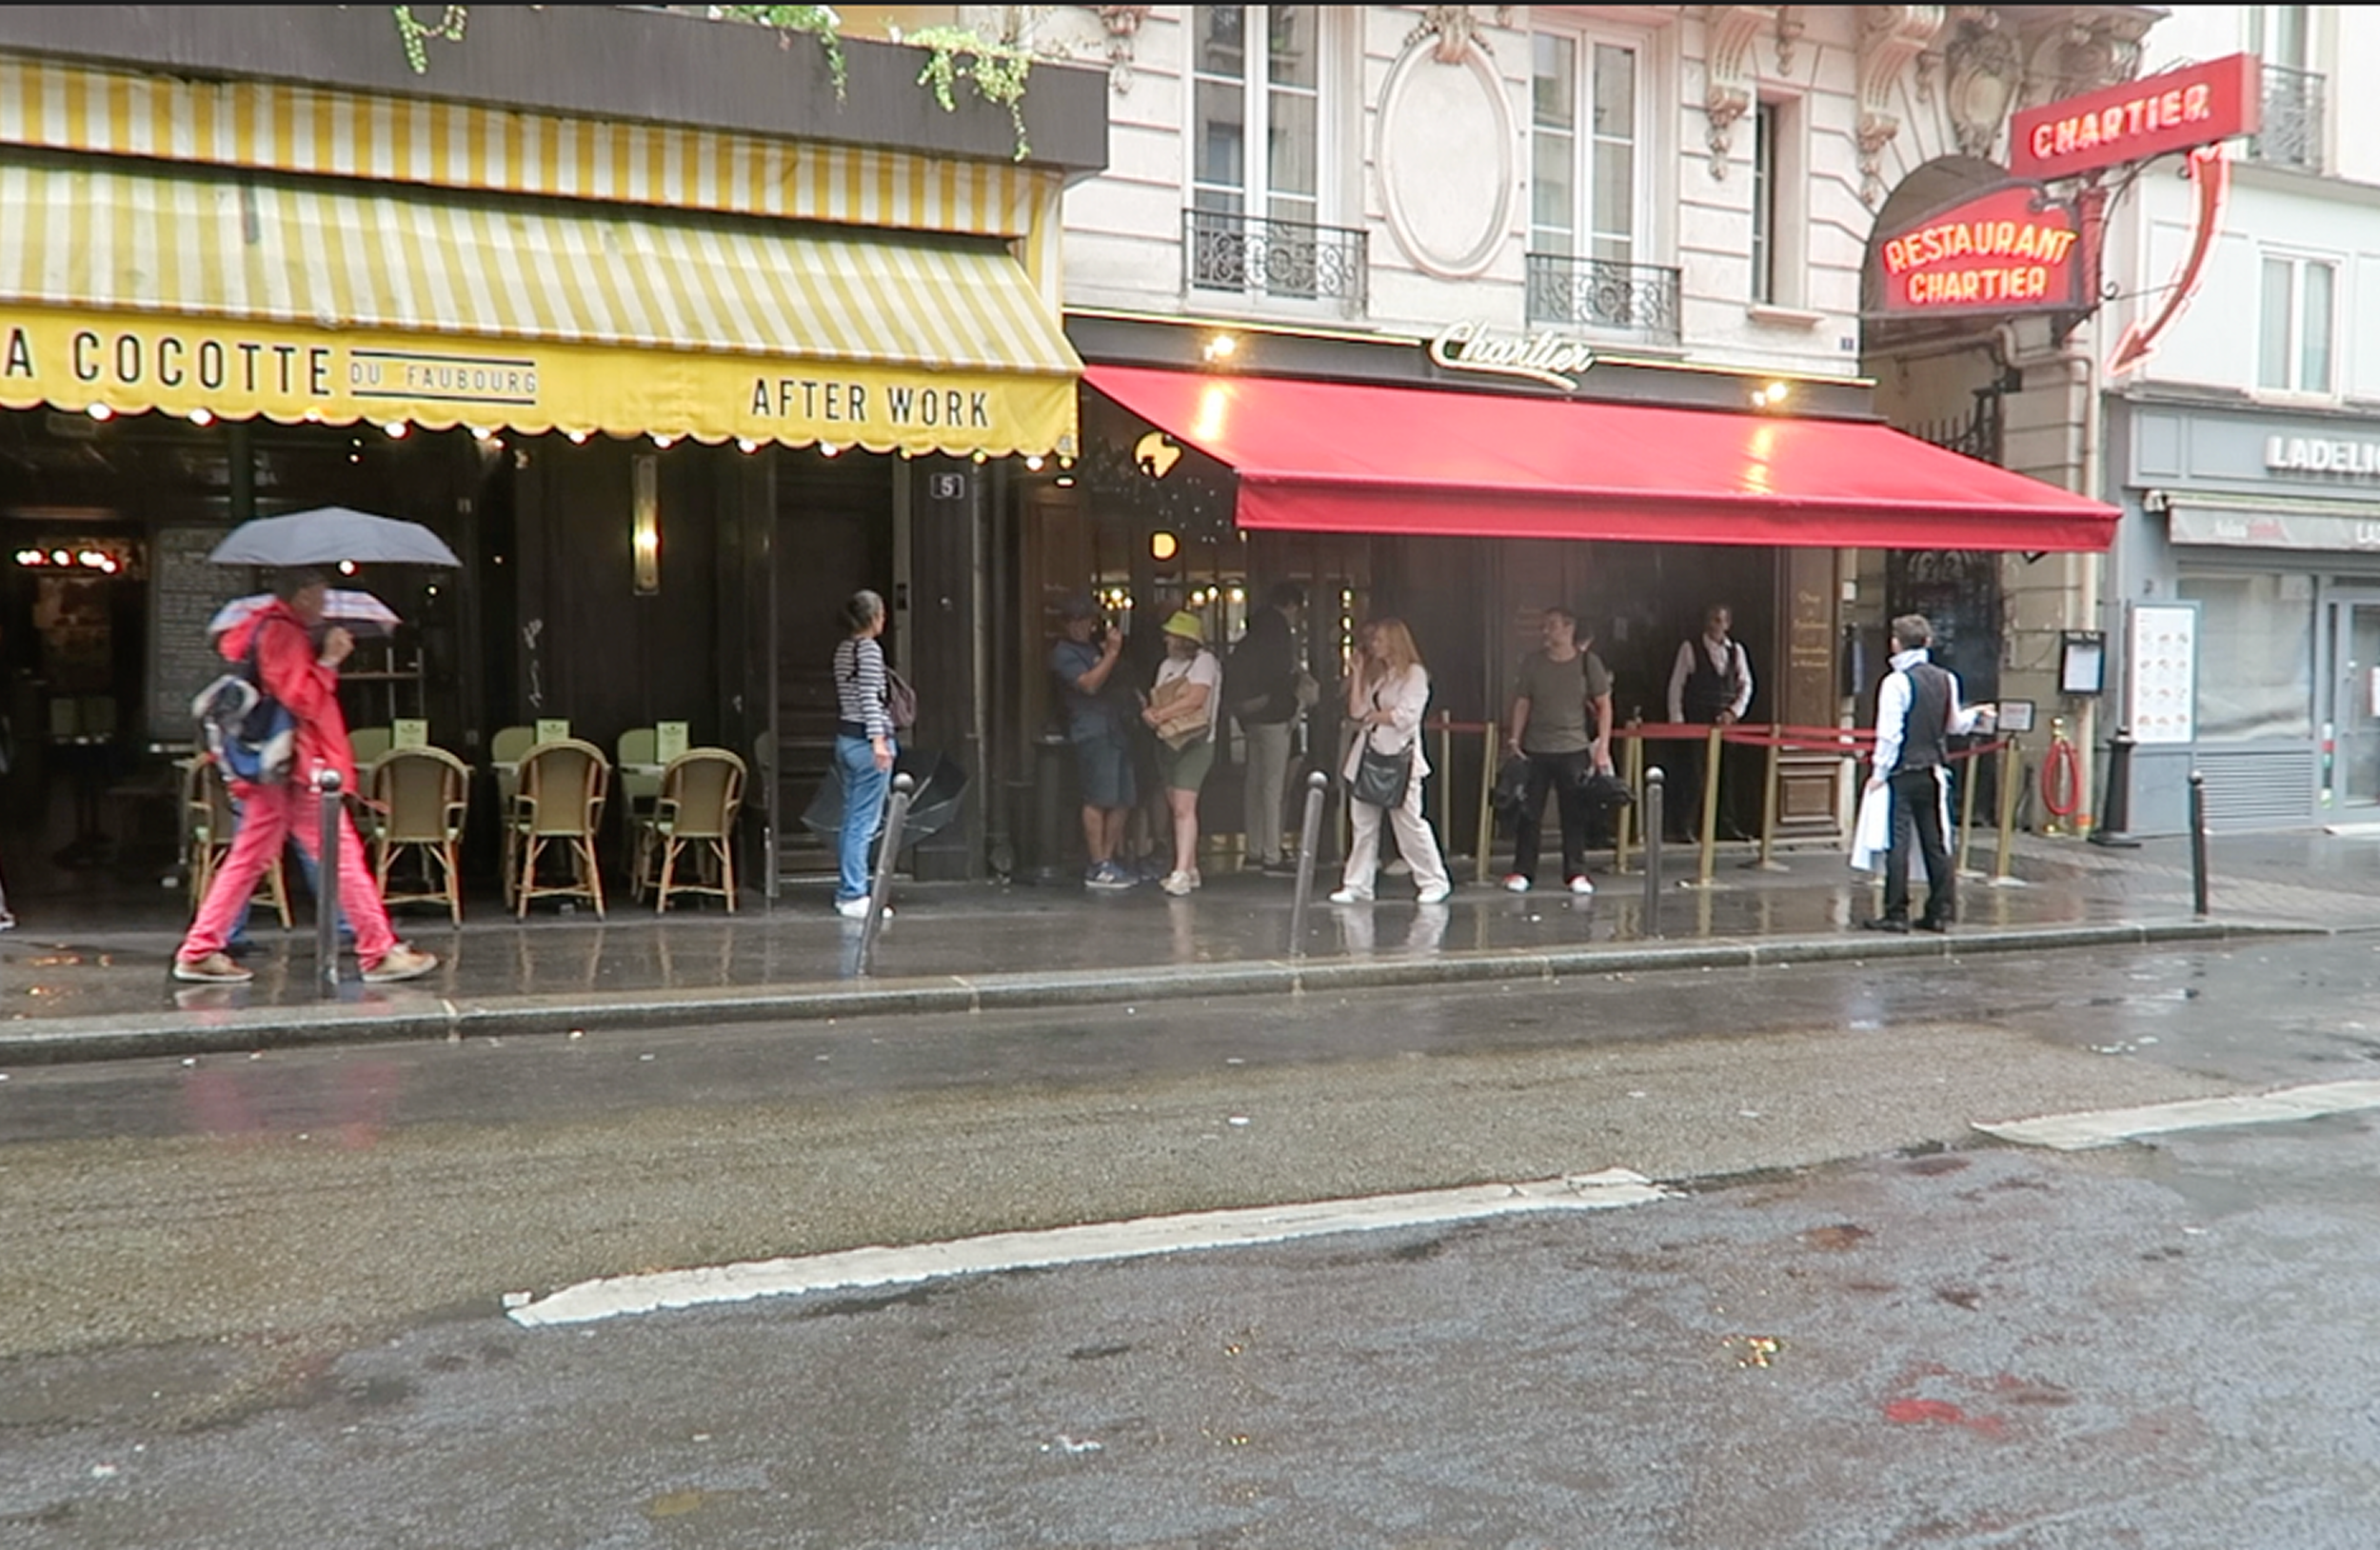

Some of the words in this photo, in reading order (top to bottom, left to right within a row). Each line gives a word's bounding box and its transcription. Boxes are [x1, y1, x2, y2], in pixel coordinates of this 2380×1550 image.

[2031, 84, 2211, 159] CHARTIER
[1883, 221, 2079, 275] RESTAURANT
[1909, 266, 2047, 304] CHARTIER
[73, 331, 330, 396] COCOTTE
[350, 362, 381, 385] DU
[407, 365, 536, 393] FAUBOURG
[1430, 320, 1596, 390] Chartier
[752, 377, 866, 422] AFTER
[887, 387, 988, 427] WORK
